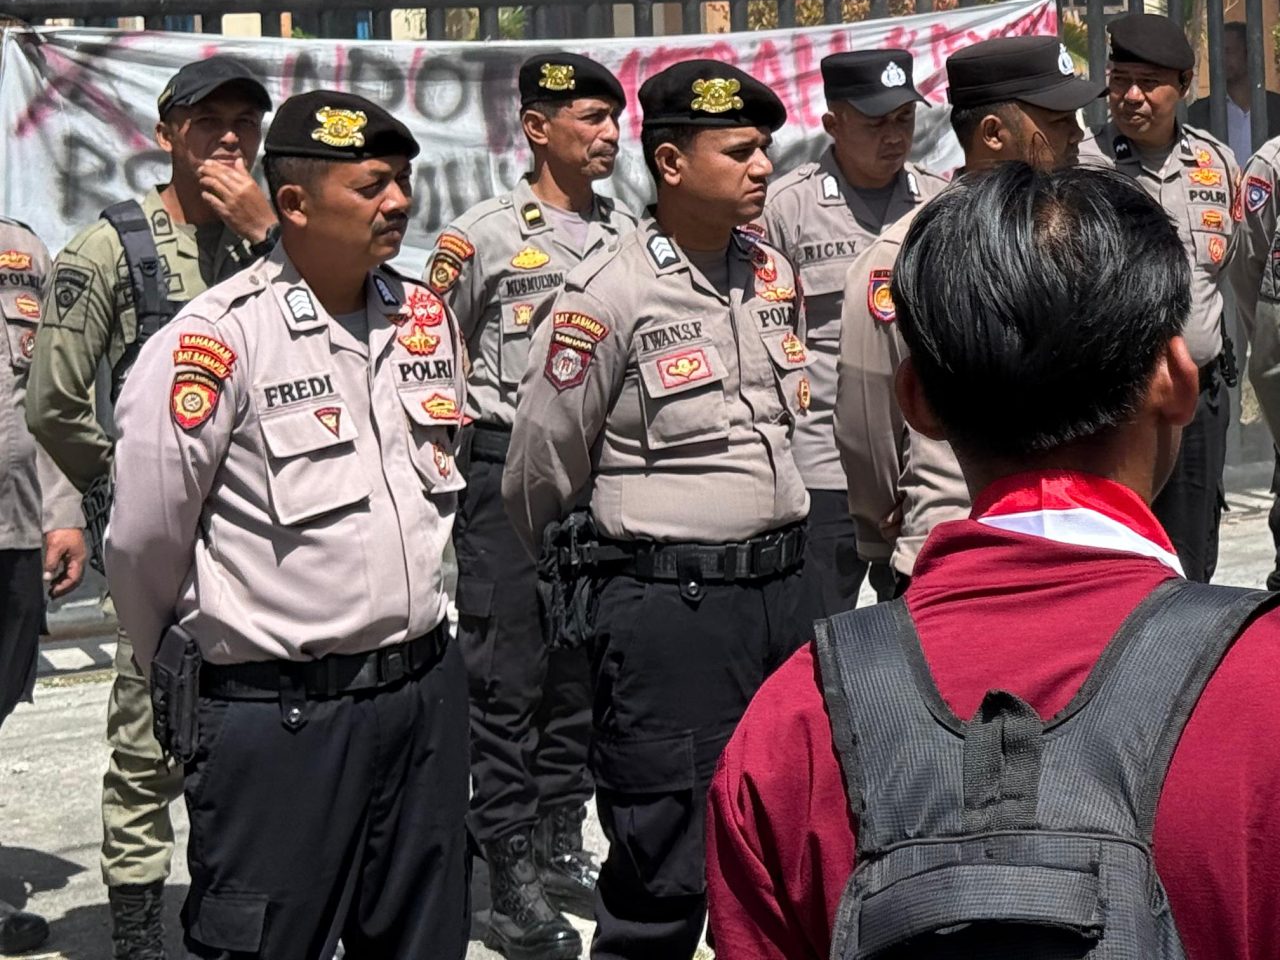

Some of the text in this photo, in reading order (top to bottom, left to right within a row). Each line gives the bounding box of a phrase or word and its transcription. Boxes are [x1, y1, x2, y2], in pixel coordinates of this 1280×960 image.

[1189, 190, 1226, 203] POLRI
[803, 240, 857, 260] RICKY
[555, 313, 570, 324] SAT
[398, 359, 453, 382] POLRI
[264, 374, 335, 408] FREDI
